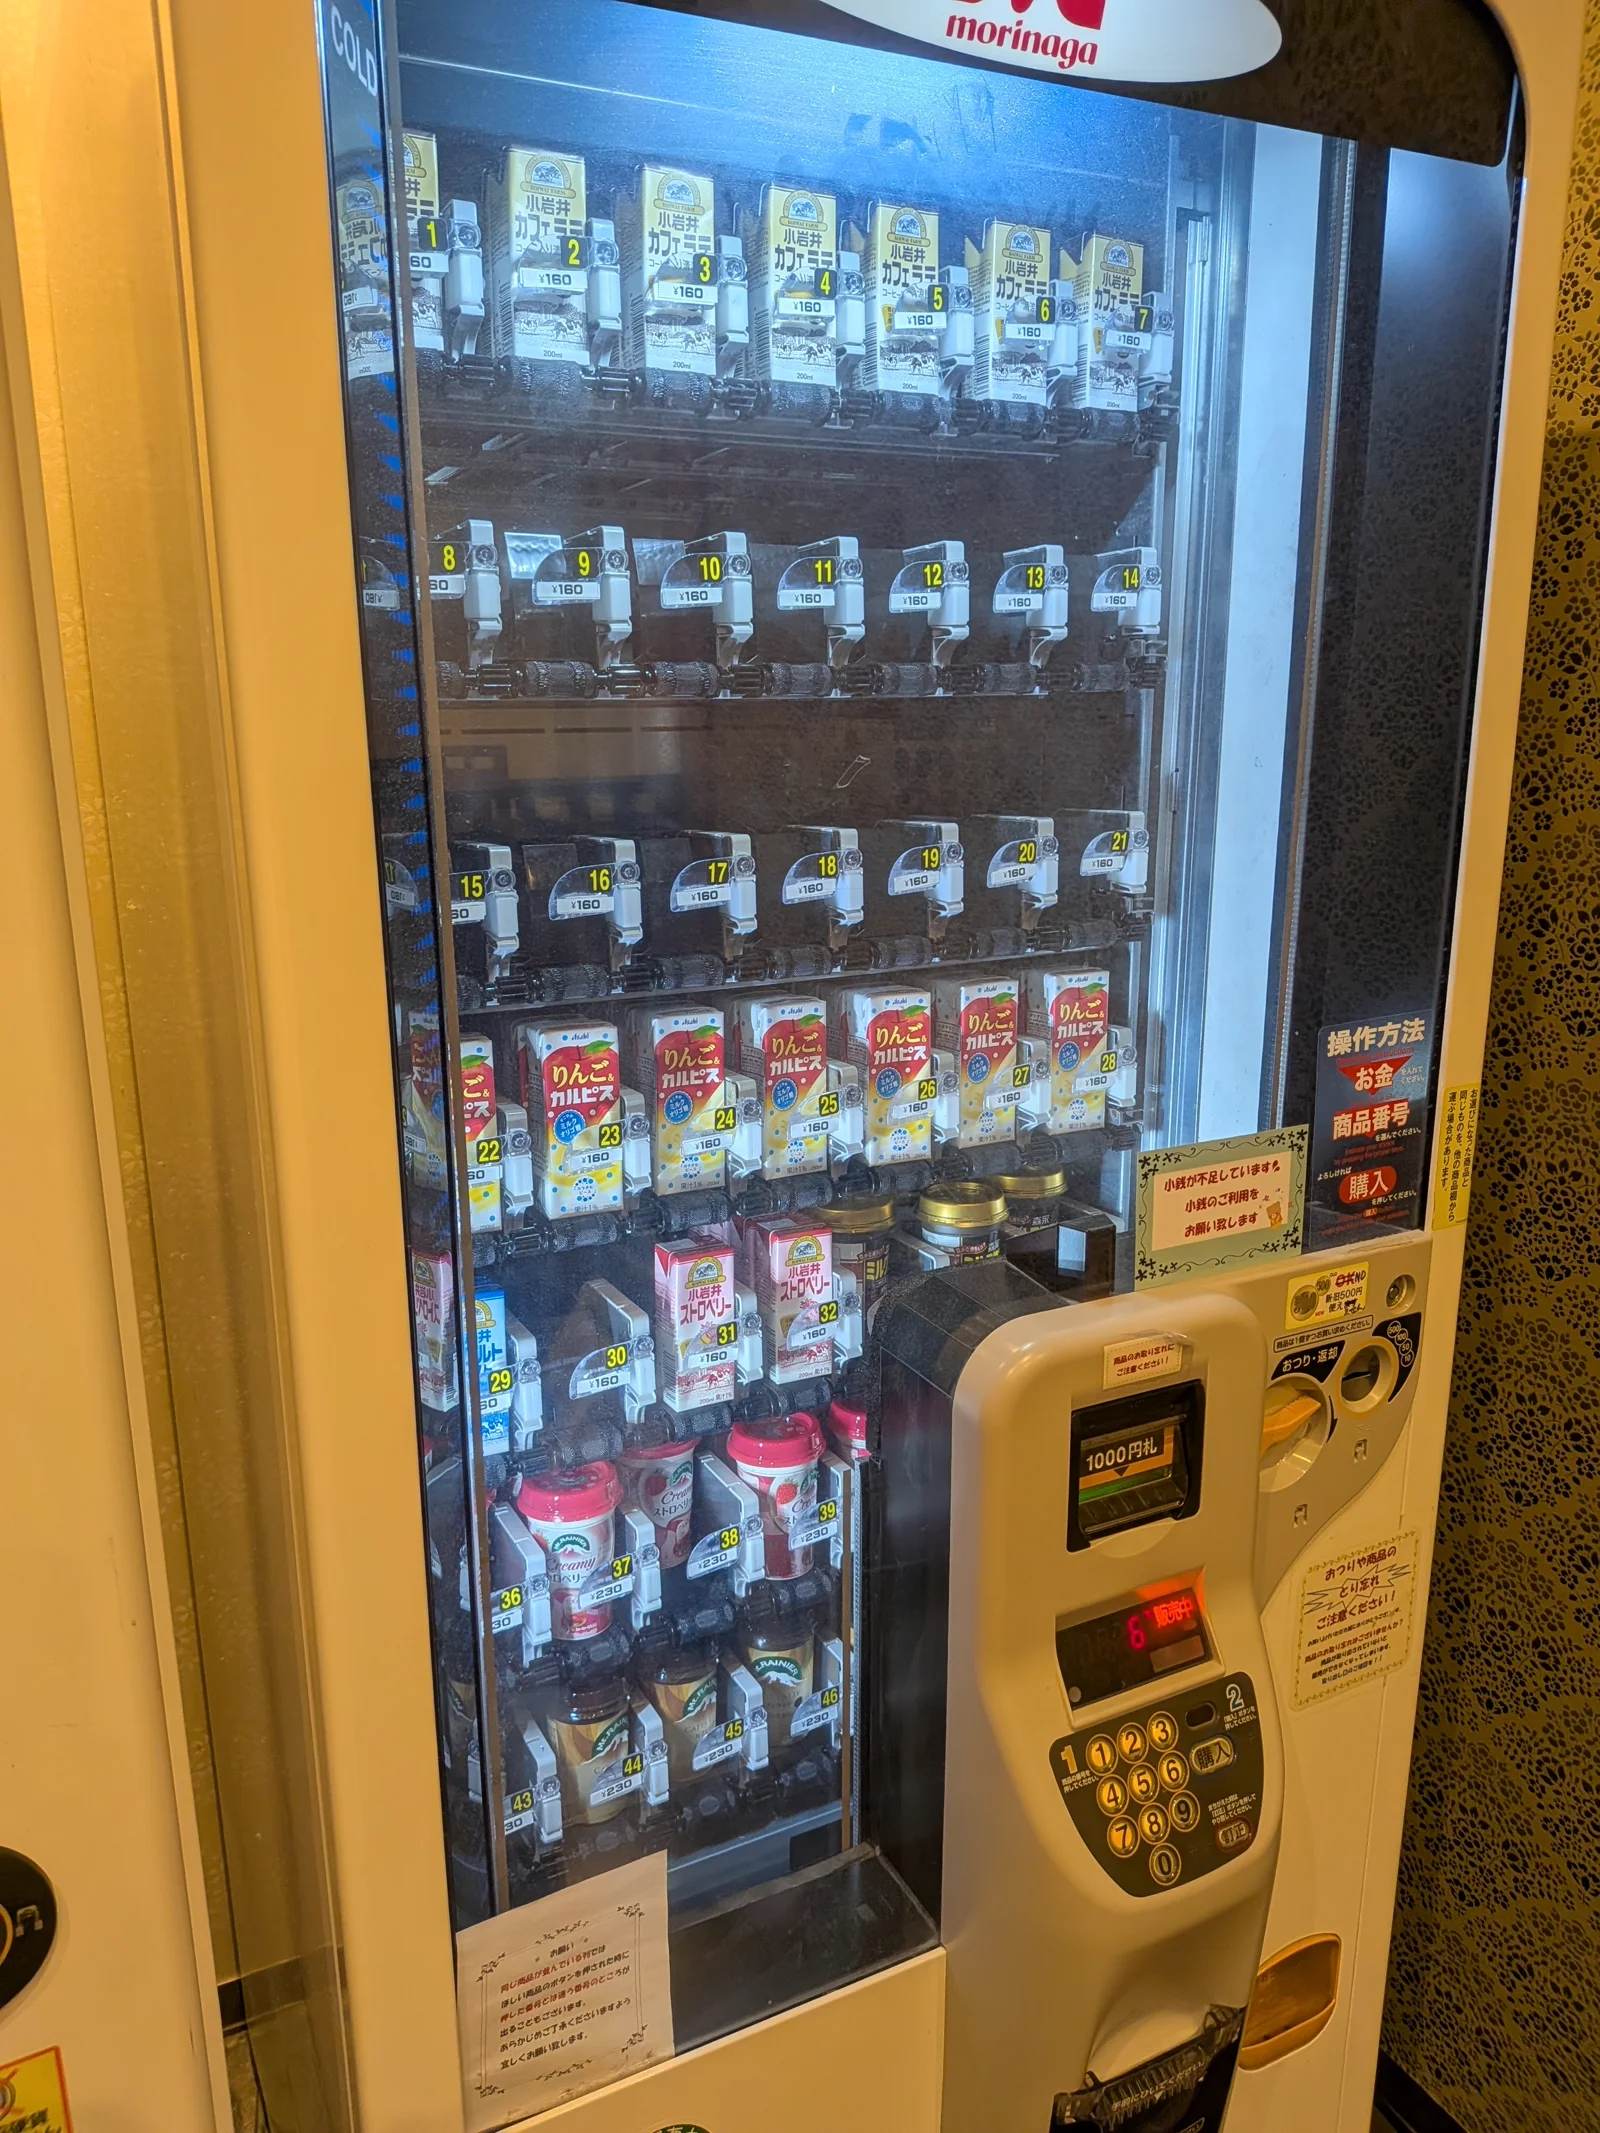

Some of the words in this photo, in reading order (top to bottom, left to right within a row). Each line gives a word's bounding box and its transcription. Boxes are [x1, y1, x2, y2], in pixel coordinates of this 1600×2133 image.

[946, 14, 1098, 69] morinaga
[330, 11, 377, 98] COLD
[526, 195, 570, 217] 小岩井
[658, 212, 700, 233] 小岩井
[427, 221, 436, 247] 1
[784, 228, 823, 249] 小岩井
[568, 240, 580, 265] 2
[539, 274, 572, 286] ¥160
[700, 256, 710, 282] 3
[820, 272, 831, 295] 4
[794, 302, 822, 313] ¥160
[933, 286, 943, 311] 5
[1040, 298, 1049, 321] 6
[1139, 309, 1148, 330] 7
[1017, 327, 1041, 338] ¥160
[443, 544, 456, 571] 8
[578, 552, 590, 576] 9
[700, 556, 721, 582] 10
[814, 560, 833, 583] 11
[924, 564, 942, 587] 12
[1027, 566, 1044, 589] 13
[1124, 567, 1139, 589] 14
[551, 584, 583, 596] ¥160
[794, 594, 822, 604] ¥160
[1008, 598, 1032, 608] ¥160
[1019, 842, 1035, 863] 20
[1112, 832, 1128, 852] 21
[818, 855, 837, 878] 18
[922, 848, 939, 870] 19
[1092, 858, 1113, 869] ¥160
[589, 868, 610, 893] 16
[708, 862, 727, 884] 17
[904, 875, 929, 887] ¥160
[460, 875, 483, 899] 15
[691, 890, 719, 902] ¥160
[1057, 1020, 1104, 1040] カルピス
[1327, 1018, 1426, 1057] 操作方法
[966, 1032, 1013, 1051] カルピス
[874, 1045, 927, 1065] カルピス
[1102, 1054, 1116, 1072] 28
[770, 1056, 823, 1077] カルピス
[1014, 1067, 1030, 1085] 27
[1355, 1062, 1394, 1091] お金
[662, 1068, 721, 1089] カルピス
[920, 1080, 935, 1099] 26
[1085, 1076, 1108, 1087] ¥160
[550, 1085, 615, 1108] カルピス
[820, 1094, 838, 1114] 25
[903, 1102, 928, 1113] ¥160
[716, 1108, 734, 1129] 24
[1332, 1102, 1410, 1140] 商品番号
[600, 1126, 620, 1145] 23
[695, 1138, 721, 1150] ¥160
[1376, 1127, 1422, 1142] を選んでください。
[1440, 1092, 1458, 1192] 運ぶ場合があります。
[478, 1140, 500, 1163] 22
[1317, 1166, 1352, 1181] よろしければ
[1349, 1170, 1389, 1201] 購入
[1185, 1188, 1260, 1213] 小銭のご利用を
[1372, 1190, 1417, 1206] を押してください。
[1185, 1212, 1259, 1238] お願い致します
[780, 1276, 830, 1302] ストロベリー
[680, 1298, 732, 1326] ストロベリー
[820, 1303, 837, 1323] 32
[718, 1324, 736, 1344] 31
[1388, 1325, 1400, 1334] 500
[606, 1346, 626, 1368] 30
[700, 1352, 728, 1363] ¥160
[1114, 1343, 1175, 1366] 商品のお取り忘れに
[1282, 1346, 1338, 1373] おつり・返却
[490, 1370, 512, 1393] 29
[1086, 1436, 1158, 1471] 1000円札
[820, 1502, 836, 1522] 39
[720, 1528, 739, 1549] 38
[800, 1526, 829, 1543] ¥230
[548, 1556, 596, 1573] Creamy
[612, 1556, 631, 1578] 37
[698, 1554, 728, 1569] ¥230
[1324, 1546, 1397, 1582] おつりや商品の
[590, 1584, 622, 1600] ¥230
[1340, 1574, 1380, 1598] とり忘れ
[502, 1588, 521, 1610] 36
[1153, 1599, 1194, 1629] 販売中
[822, 1688, 838, 1706] 46
[1226, 1684, 1245, 1713] 2
[726, 1720, 743, 1738] 45
[1156, 1720, 1170, 1742] 3
[704, 1744, 733, 1762] ¥230
[1126, 1732, 1140, 1754] 2
[624, 1756, 642, 1775] 44
[1060, 1744, 1078, 1775] 1
[1096, 1743, 1107, 1766] 1
[1196, 1742, 1231, 1771] 購入
[1168, 1760, 1180, 1783] 6
[602, 1779, 633, 1798] ¥230
[1107, 1783, 1120, 1806] 4
[1138, 1772, 1150, 1795] 5
[514, 1792, 532, 1812] 43
[1177, 1799, 1190, 1823] 9
[1148, 1812, 1160, 1836] 8
[1116, 1826, 1129, 1849] 7
[1158, 1854, 1171, 1877] 0
[550, 1942, 574, 1959] お願い
[500, 1944, 606, 1994] 同じ商品が並んでいる列では
[501, 1950, 630, 2010] ほしい商品のボタンを押された時に
[500, 1964, 631, 2023] 押した番号とは違う番号のところが
[500, 2001, 587, 2039] 出ることもございます。
[500, 1997, 631, 2054] あらかじめご了承くださいますよう
[500, 2032, 588, 2071] 宜しくお願い致します。
